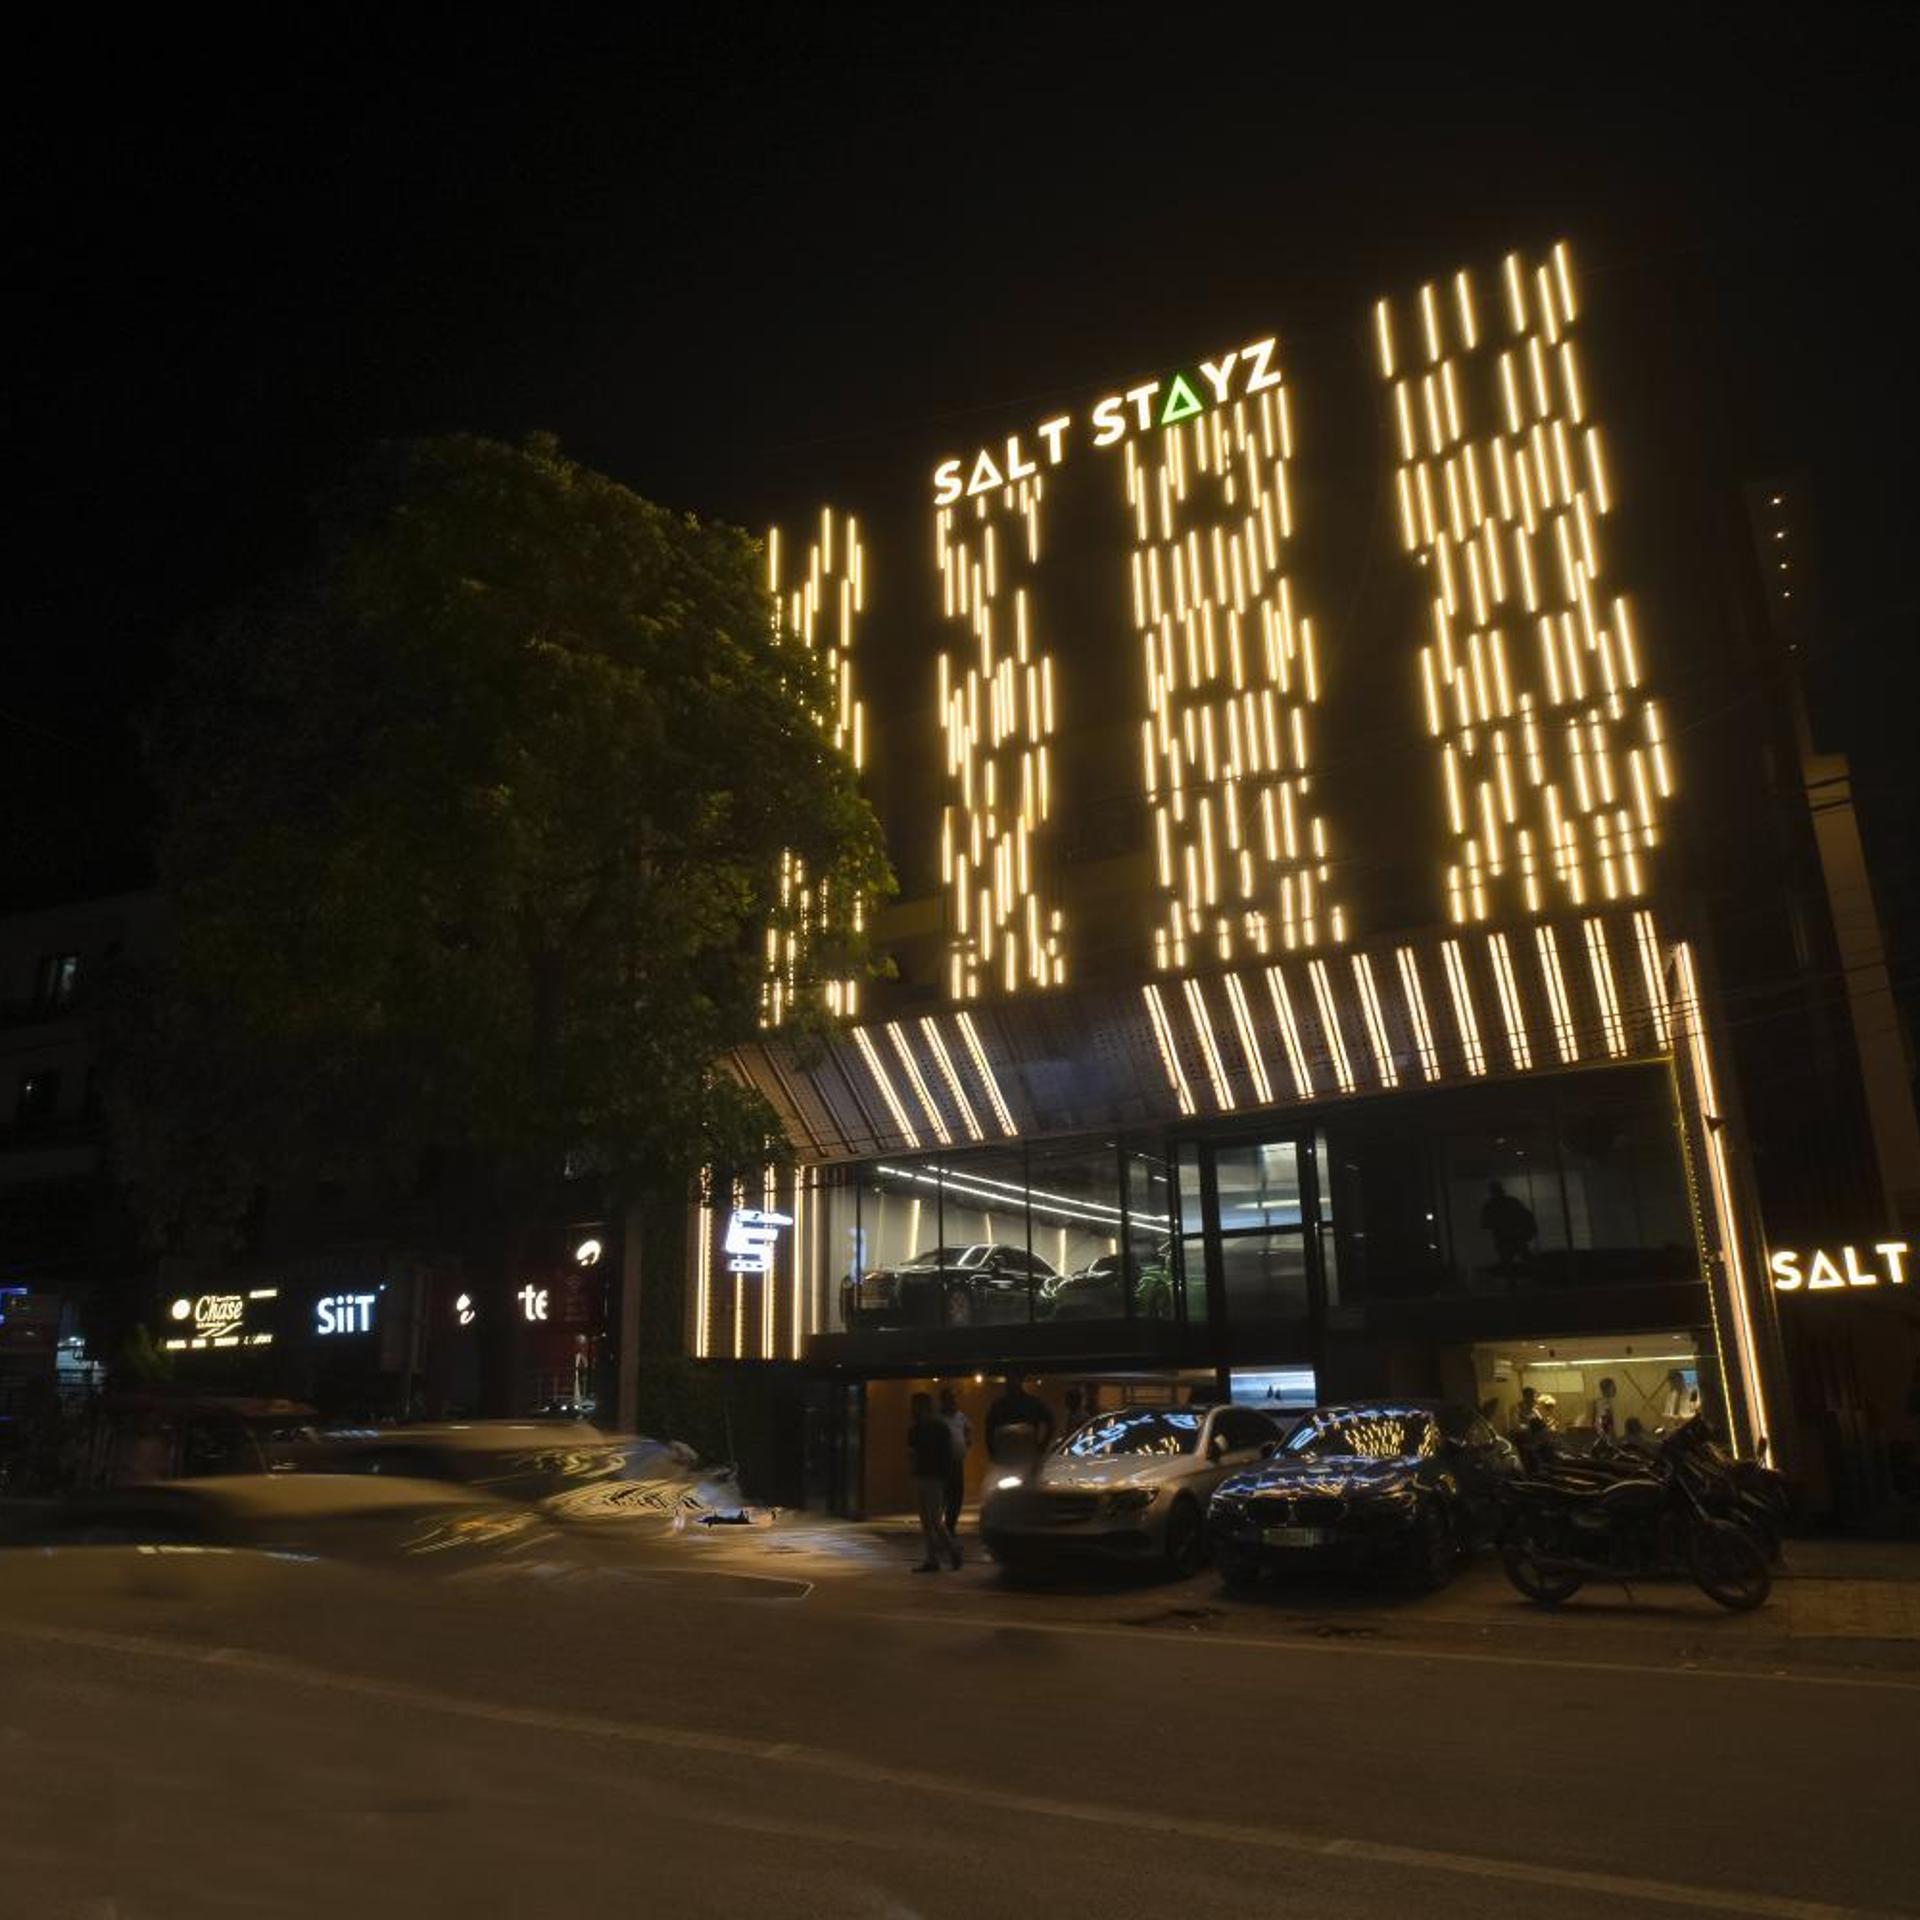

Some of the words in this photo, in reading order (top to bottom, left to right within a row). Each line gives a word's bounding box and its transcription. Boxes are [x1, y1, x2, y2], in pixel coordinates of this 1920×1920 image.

[934, 416, 1071, 505] SALT
[1092, 337, 1282, 447] STAYZ
[1771, 1242, 1908, 1290] SALT
[195, 1295, 243, 1321] Chase
